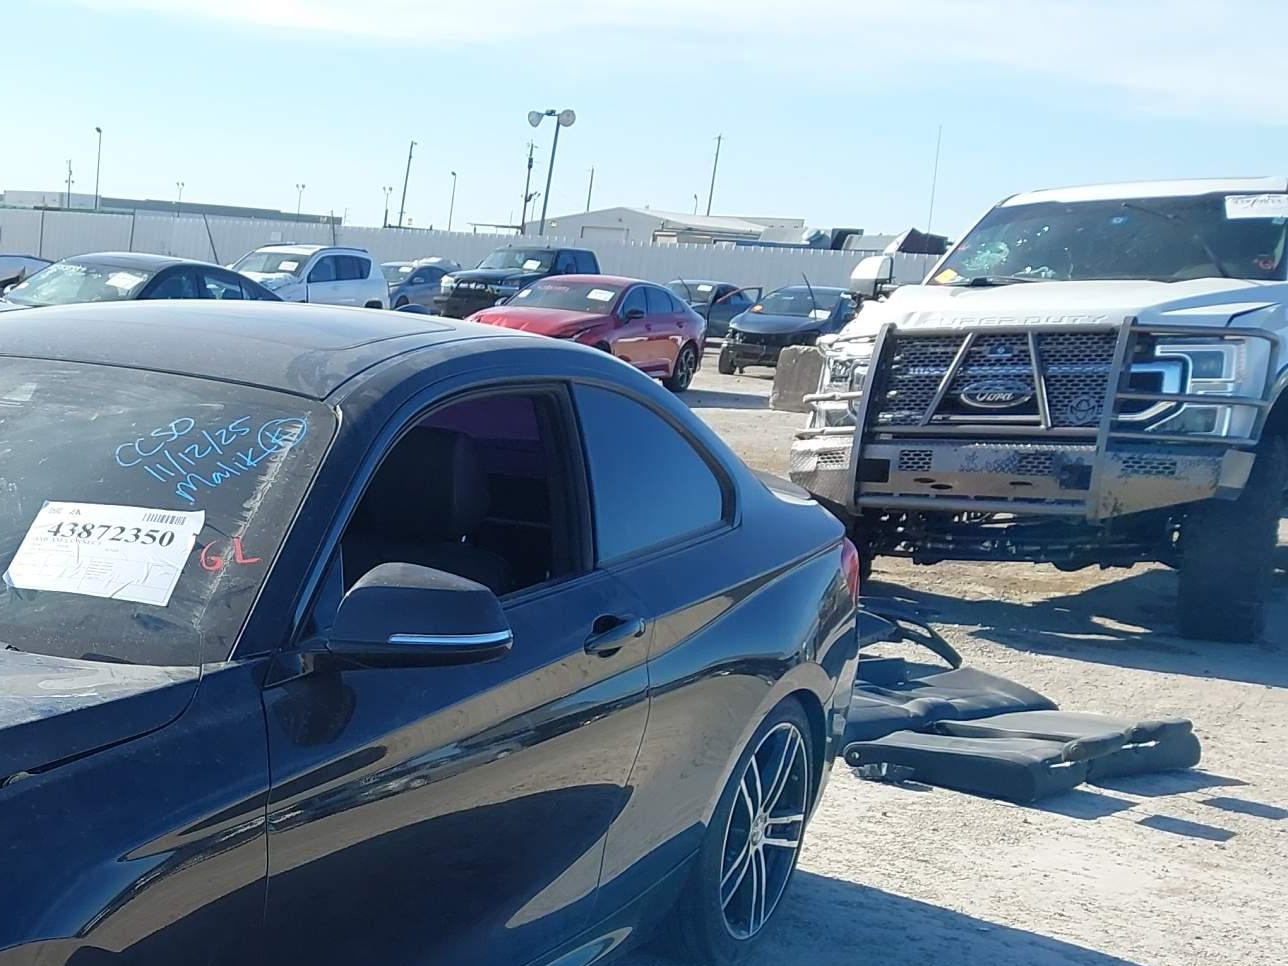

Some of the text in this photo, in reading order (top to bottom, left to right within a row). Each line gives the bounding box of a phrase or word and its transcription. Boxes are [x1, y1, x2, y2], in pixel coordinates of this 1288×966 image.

[975, 390, 1015, 402] Ford
[144, 415, 251, 482] 11/12/25
[47, 520, 175, 547] 43872350
